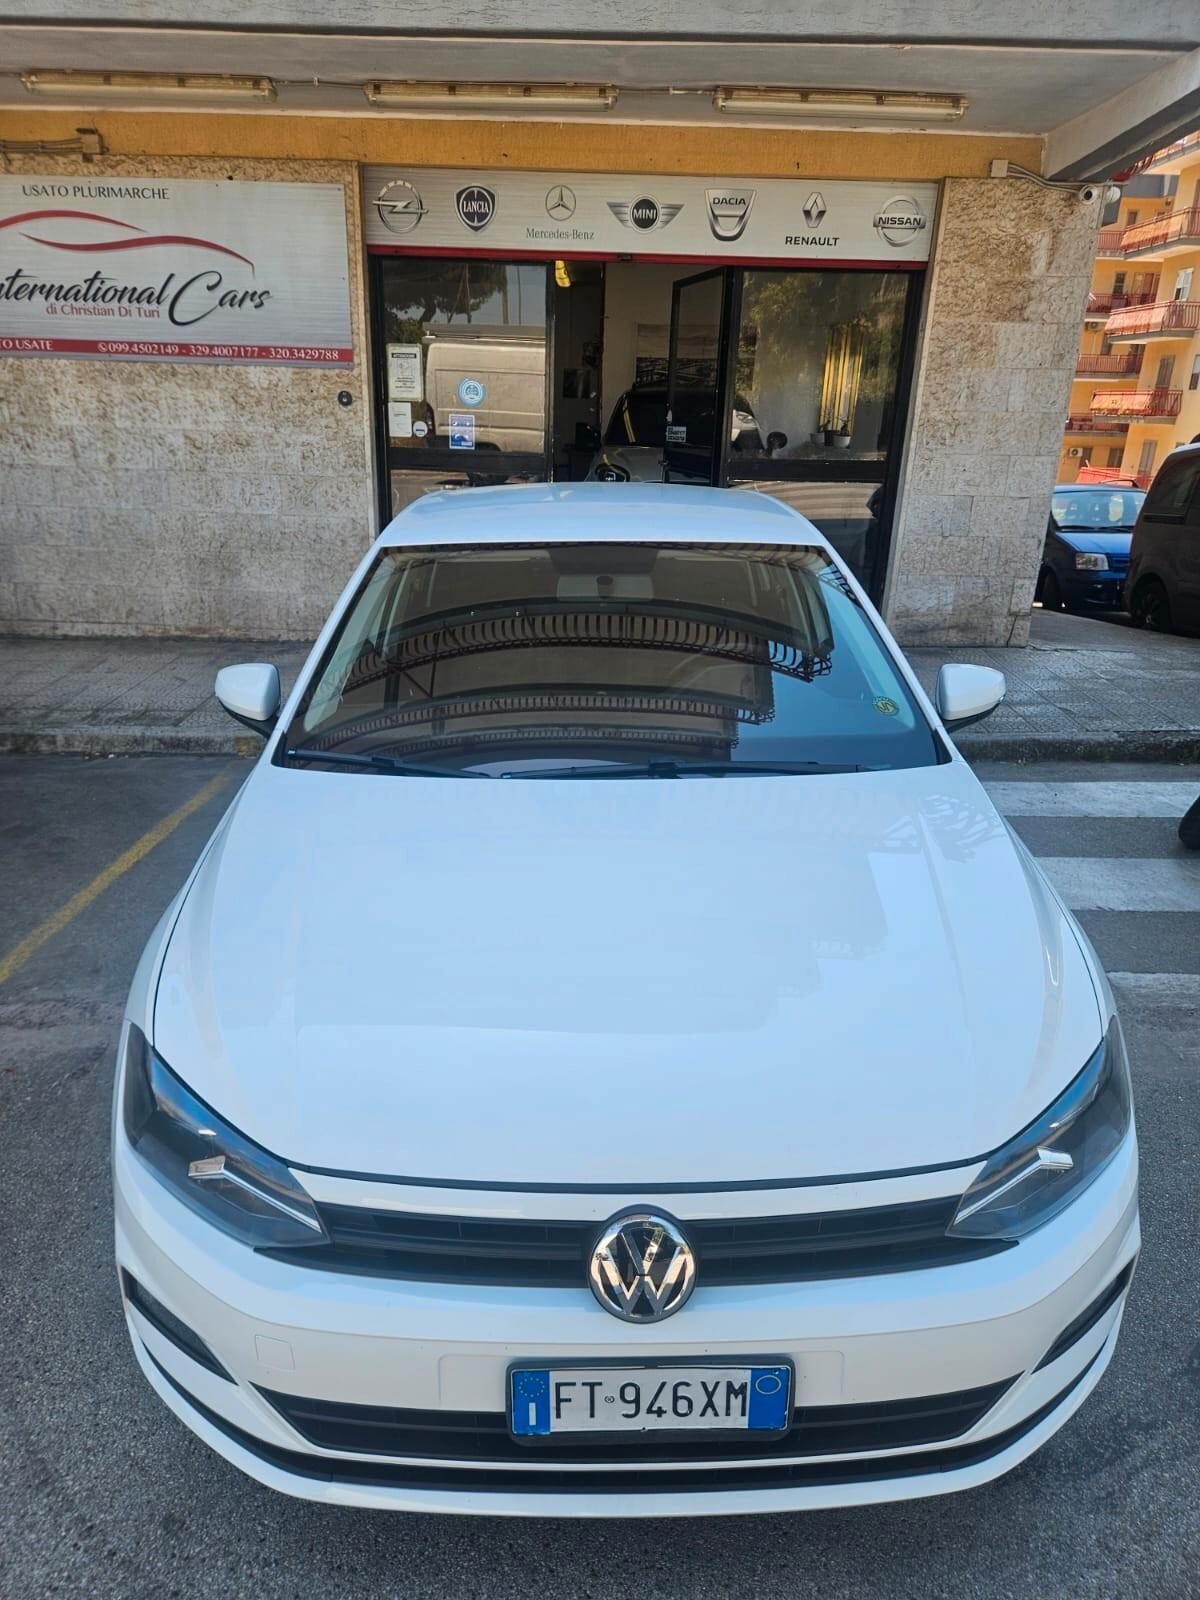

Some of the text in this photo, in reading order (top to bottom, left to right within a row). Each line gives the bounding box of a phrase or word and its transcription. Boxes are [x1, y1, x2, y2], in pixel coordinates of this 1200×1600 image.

[22, 185, 169, 200] USATO PLURIMARCHE
[463, 200, 490, 214] LANCIA
[712, 196, 746, 207] DACIA
[633, 208, 657, 220] MINI
[877, 216, 922, 227] NISSAN
[526, 227, 595, 241] Mercedes-Benz
[784, 235, 840, 247] RENAULT
[0, 268, 273, 326] ternational Cars
[46, 302, 160, 319] di Christian Di Turi
[15, 339, 54, 351] USATE
